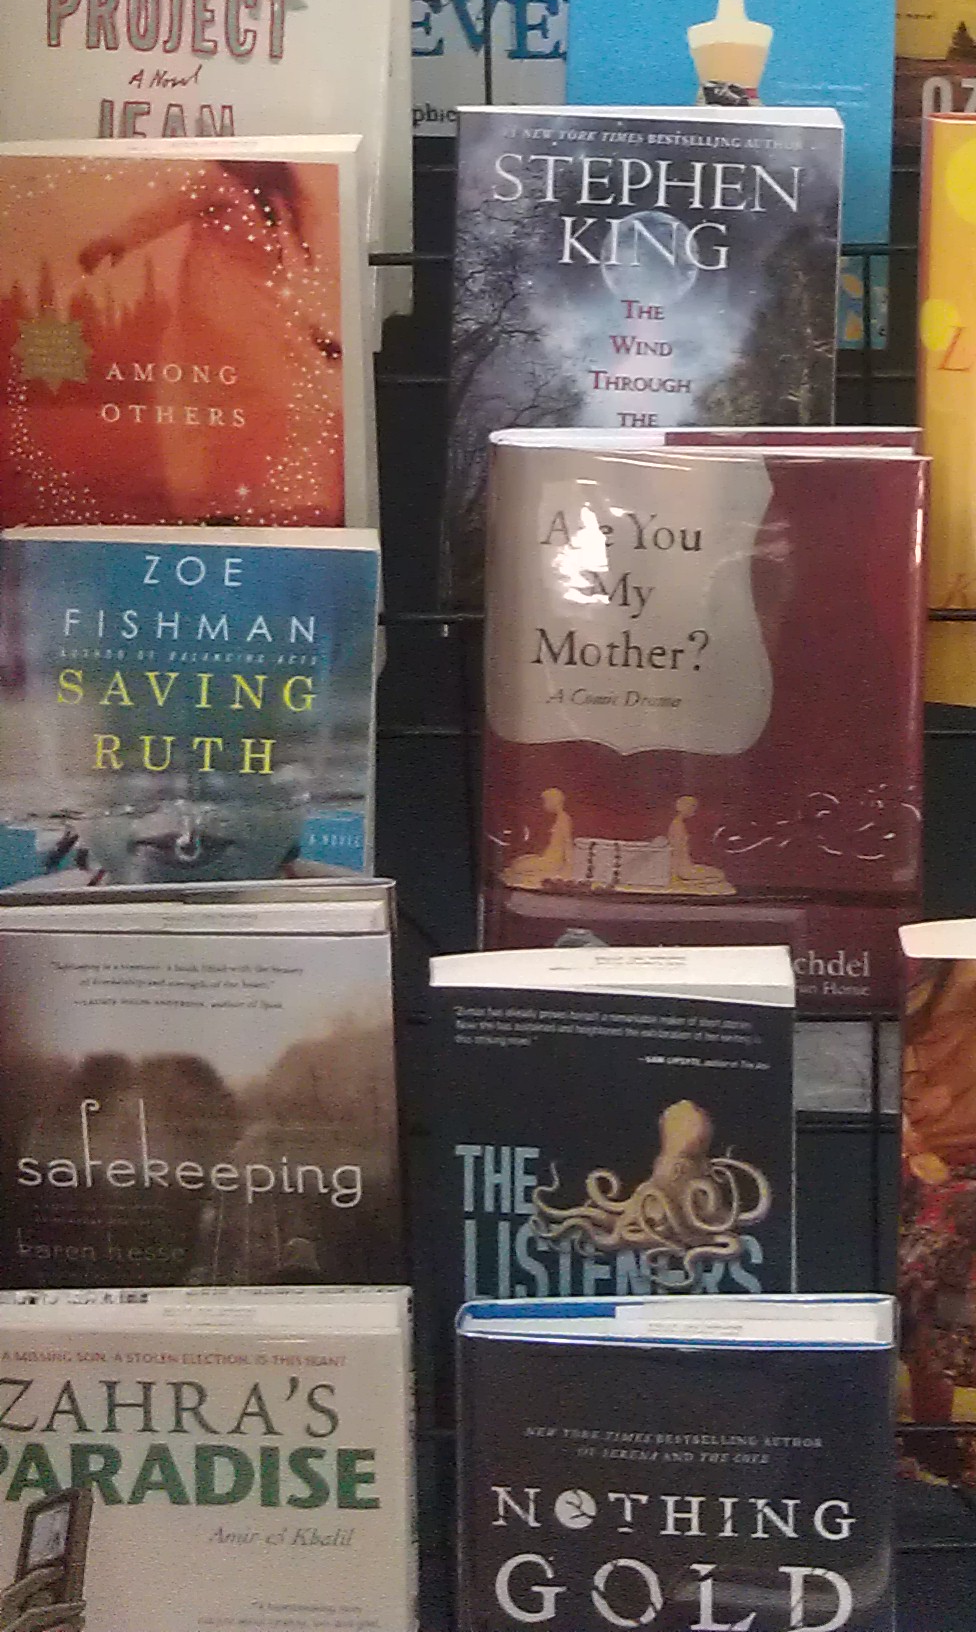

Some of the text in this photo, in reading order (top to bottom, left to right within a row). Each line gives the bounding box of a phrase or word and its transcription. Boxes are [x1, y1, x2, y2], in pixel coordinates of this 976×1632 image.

[129, 70, 145, 90] A
[492, 152, 800, 214] STEPHEN
[558, 214, 730, 271] KING
[106, 362, 239, 387] AMONG
[101, 404, 247, 428] OTHERS
[540, 510, 702, 552] Ae You
[143, 555, 243, 587] ZOE
[578, 571, 655, 619] My
[63, 608, 315, 644] FISHMAN
[530, 628, 709, 671] Mother?
[57, 669, 317, 712] SAVING
[93, 734, 277, 775] RUTH
[17, 1099, 363, 1208] safekeeping
[454, 1144, 540, 1215] THE
[0, 1376, 340, 1438] ZAHRA'S
[0, 1443, 382, 1510] ARADISE
[491, 1486, 856, 1541] NOTHING
[495, 1553, 853, 1632] GOLD
